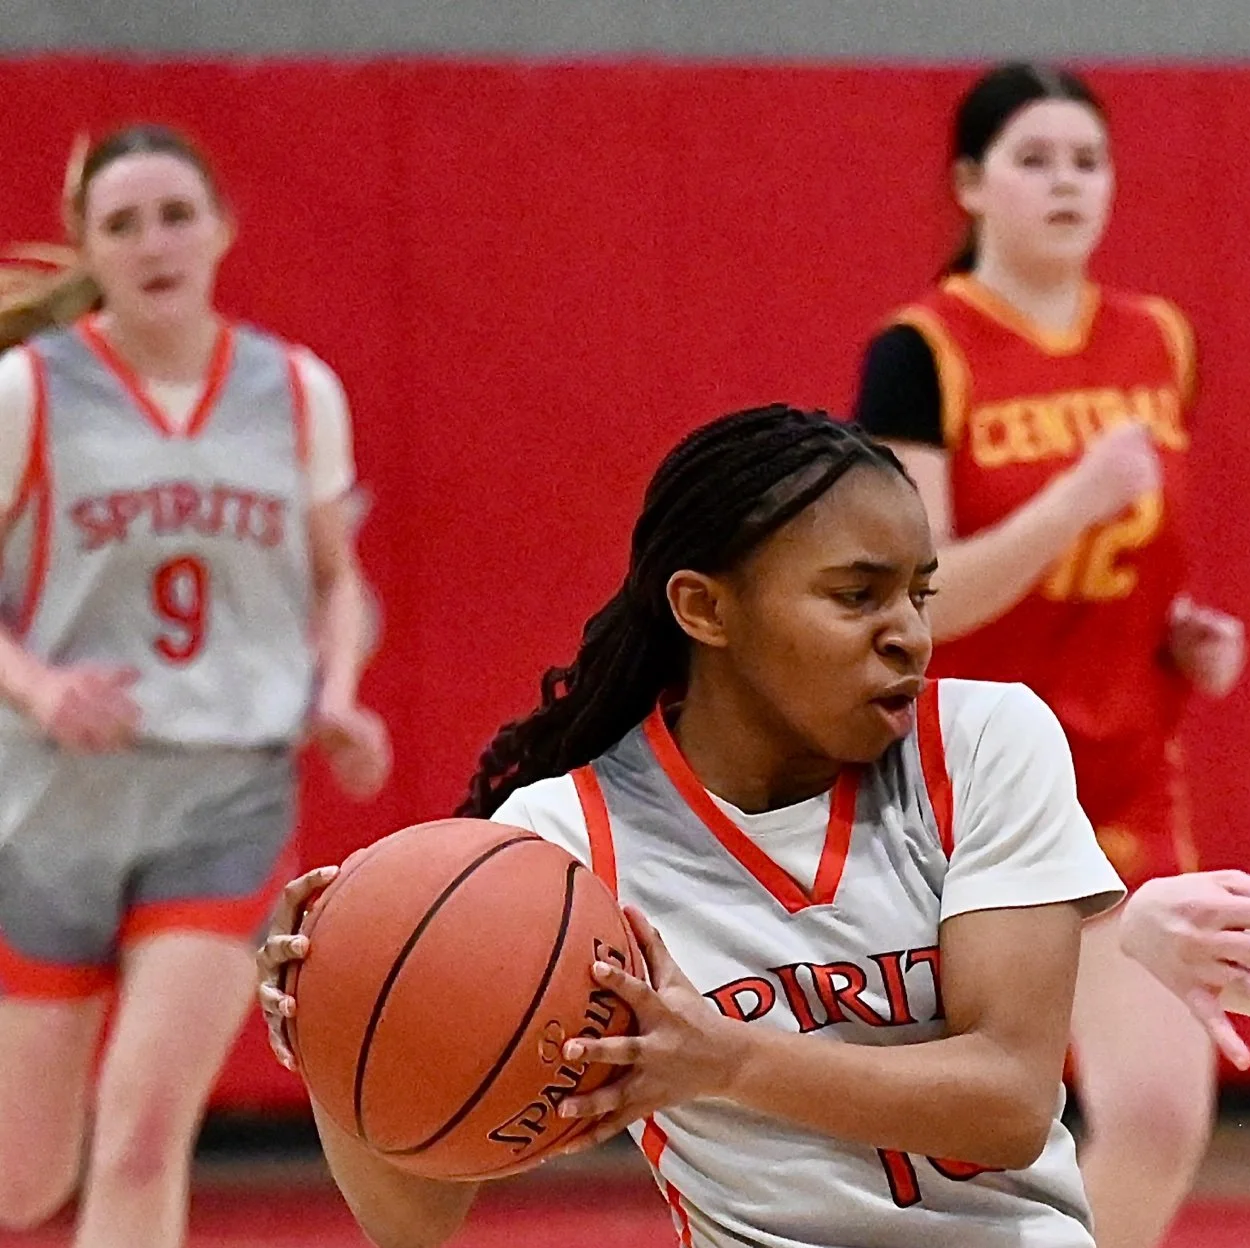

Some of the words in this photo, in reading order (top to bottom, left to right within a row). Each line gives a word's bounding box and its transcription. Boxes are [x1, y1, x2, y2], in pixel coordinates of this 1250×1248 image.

[68, 480, 286, 551] SPIRITS
[153, 554, 208, 667] 9
[702, 944, 946, 1034] PIRIT
